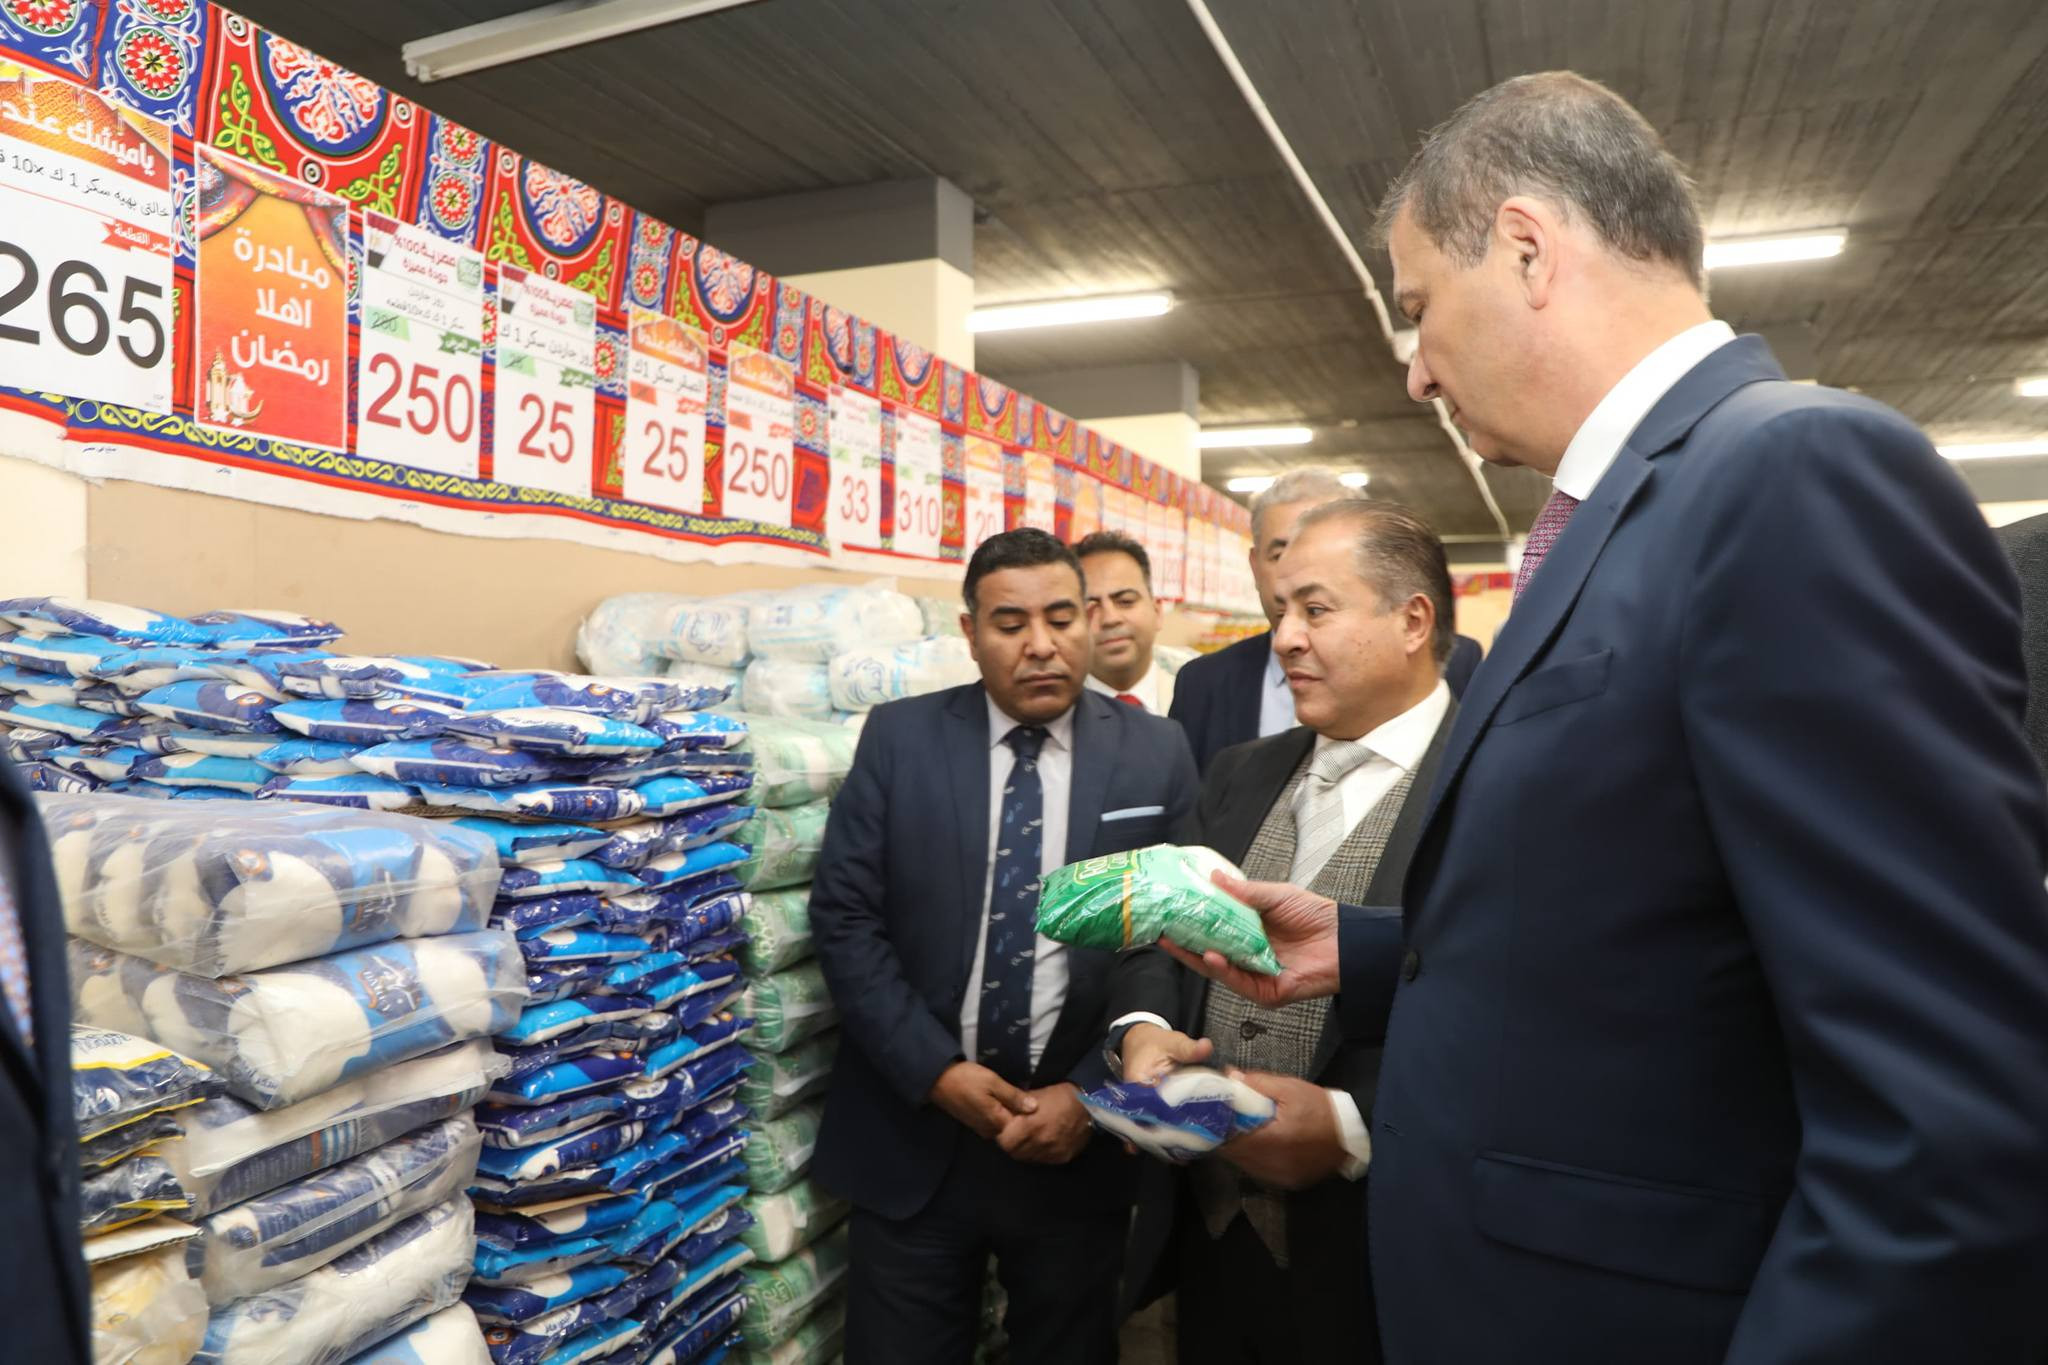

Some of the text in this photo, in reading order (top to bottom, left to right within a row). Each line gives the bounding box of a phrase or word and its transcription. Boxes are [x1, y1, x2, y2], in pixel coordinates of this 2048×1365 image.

[233, 226, 330, 290] مبادرة
[0, 240, 165, 370] 265
[255, 288, 313, 329] اهلا
[231, 329, 330, 387] رمضان
[365, 352, 475, 444] 250
[517, 393, 575, 464] 25
[643, 419, 689, 483] 25
[728, 441, 789, 502] 250
[841, 475, 870, 524] 33
[899, 490, 941, 537] 310
